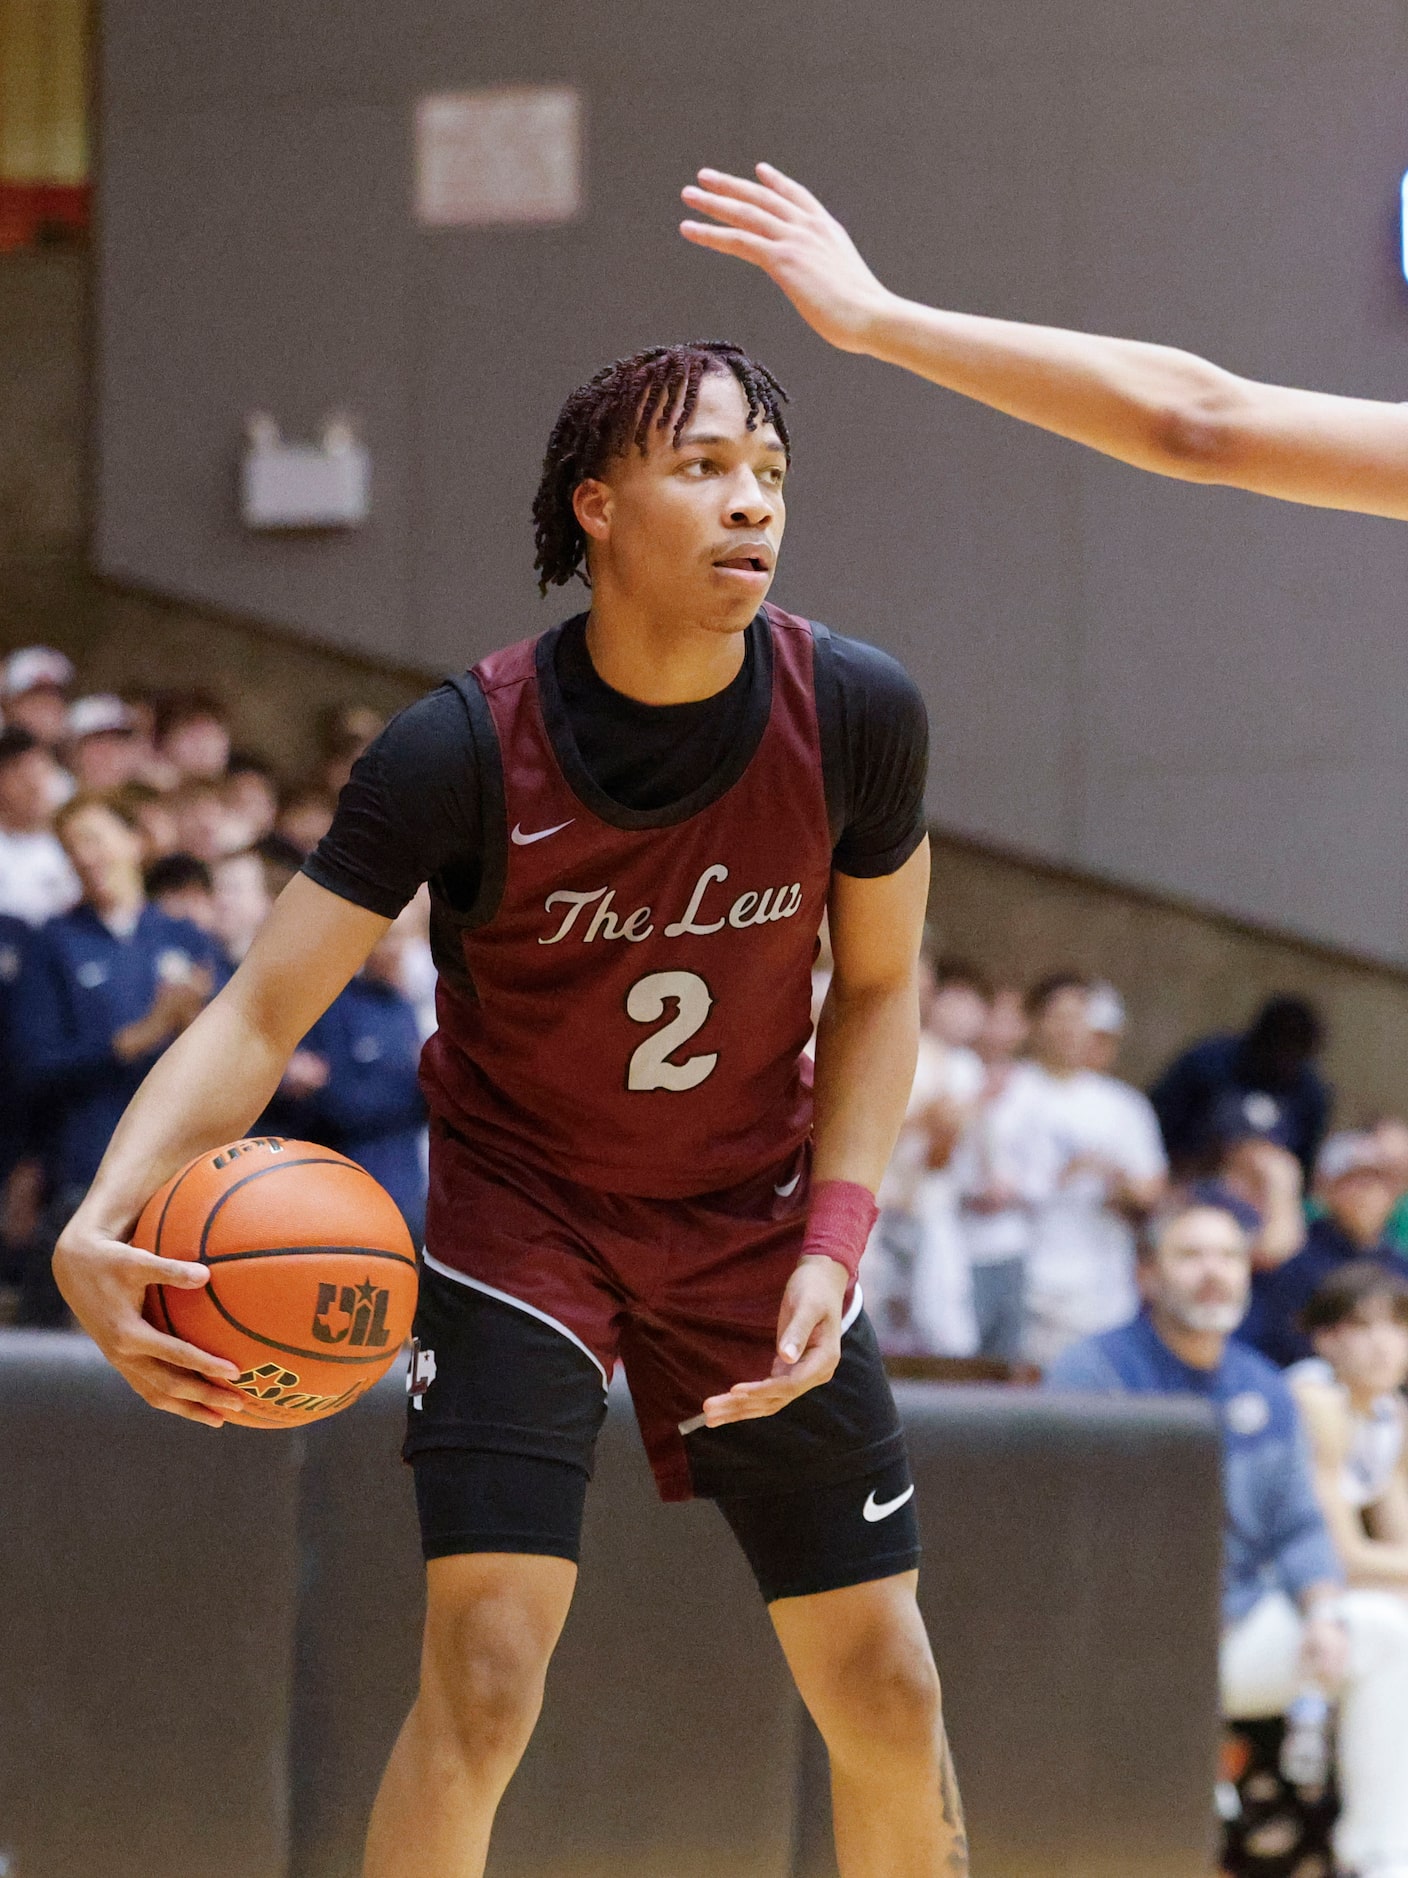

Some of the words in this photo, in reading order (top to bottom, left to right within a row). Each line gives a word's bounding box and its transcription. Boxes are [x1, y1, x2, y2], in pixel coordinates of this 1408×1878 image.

[538, 886, 654, 945] The
[663, 863, 803, 938] Lew
[625, 970, 719, 1092] 2
